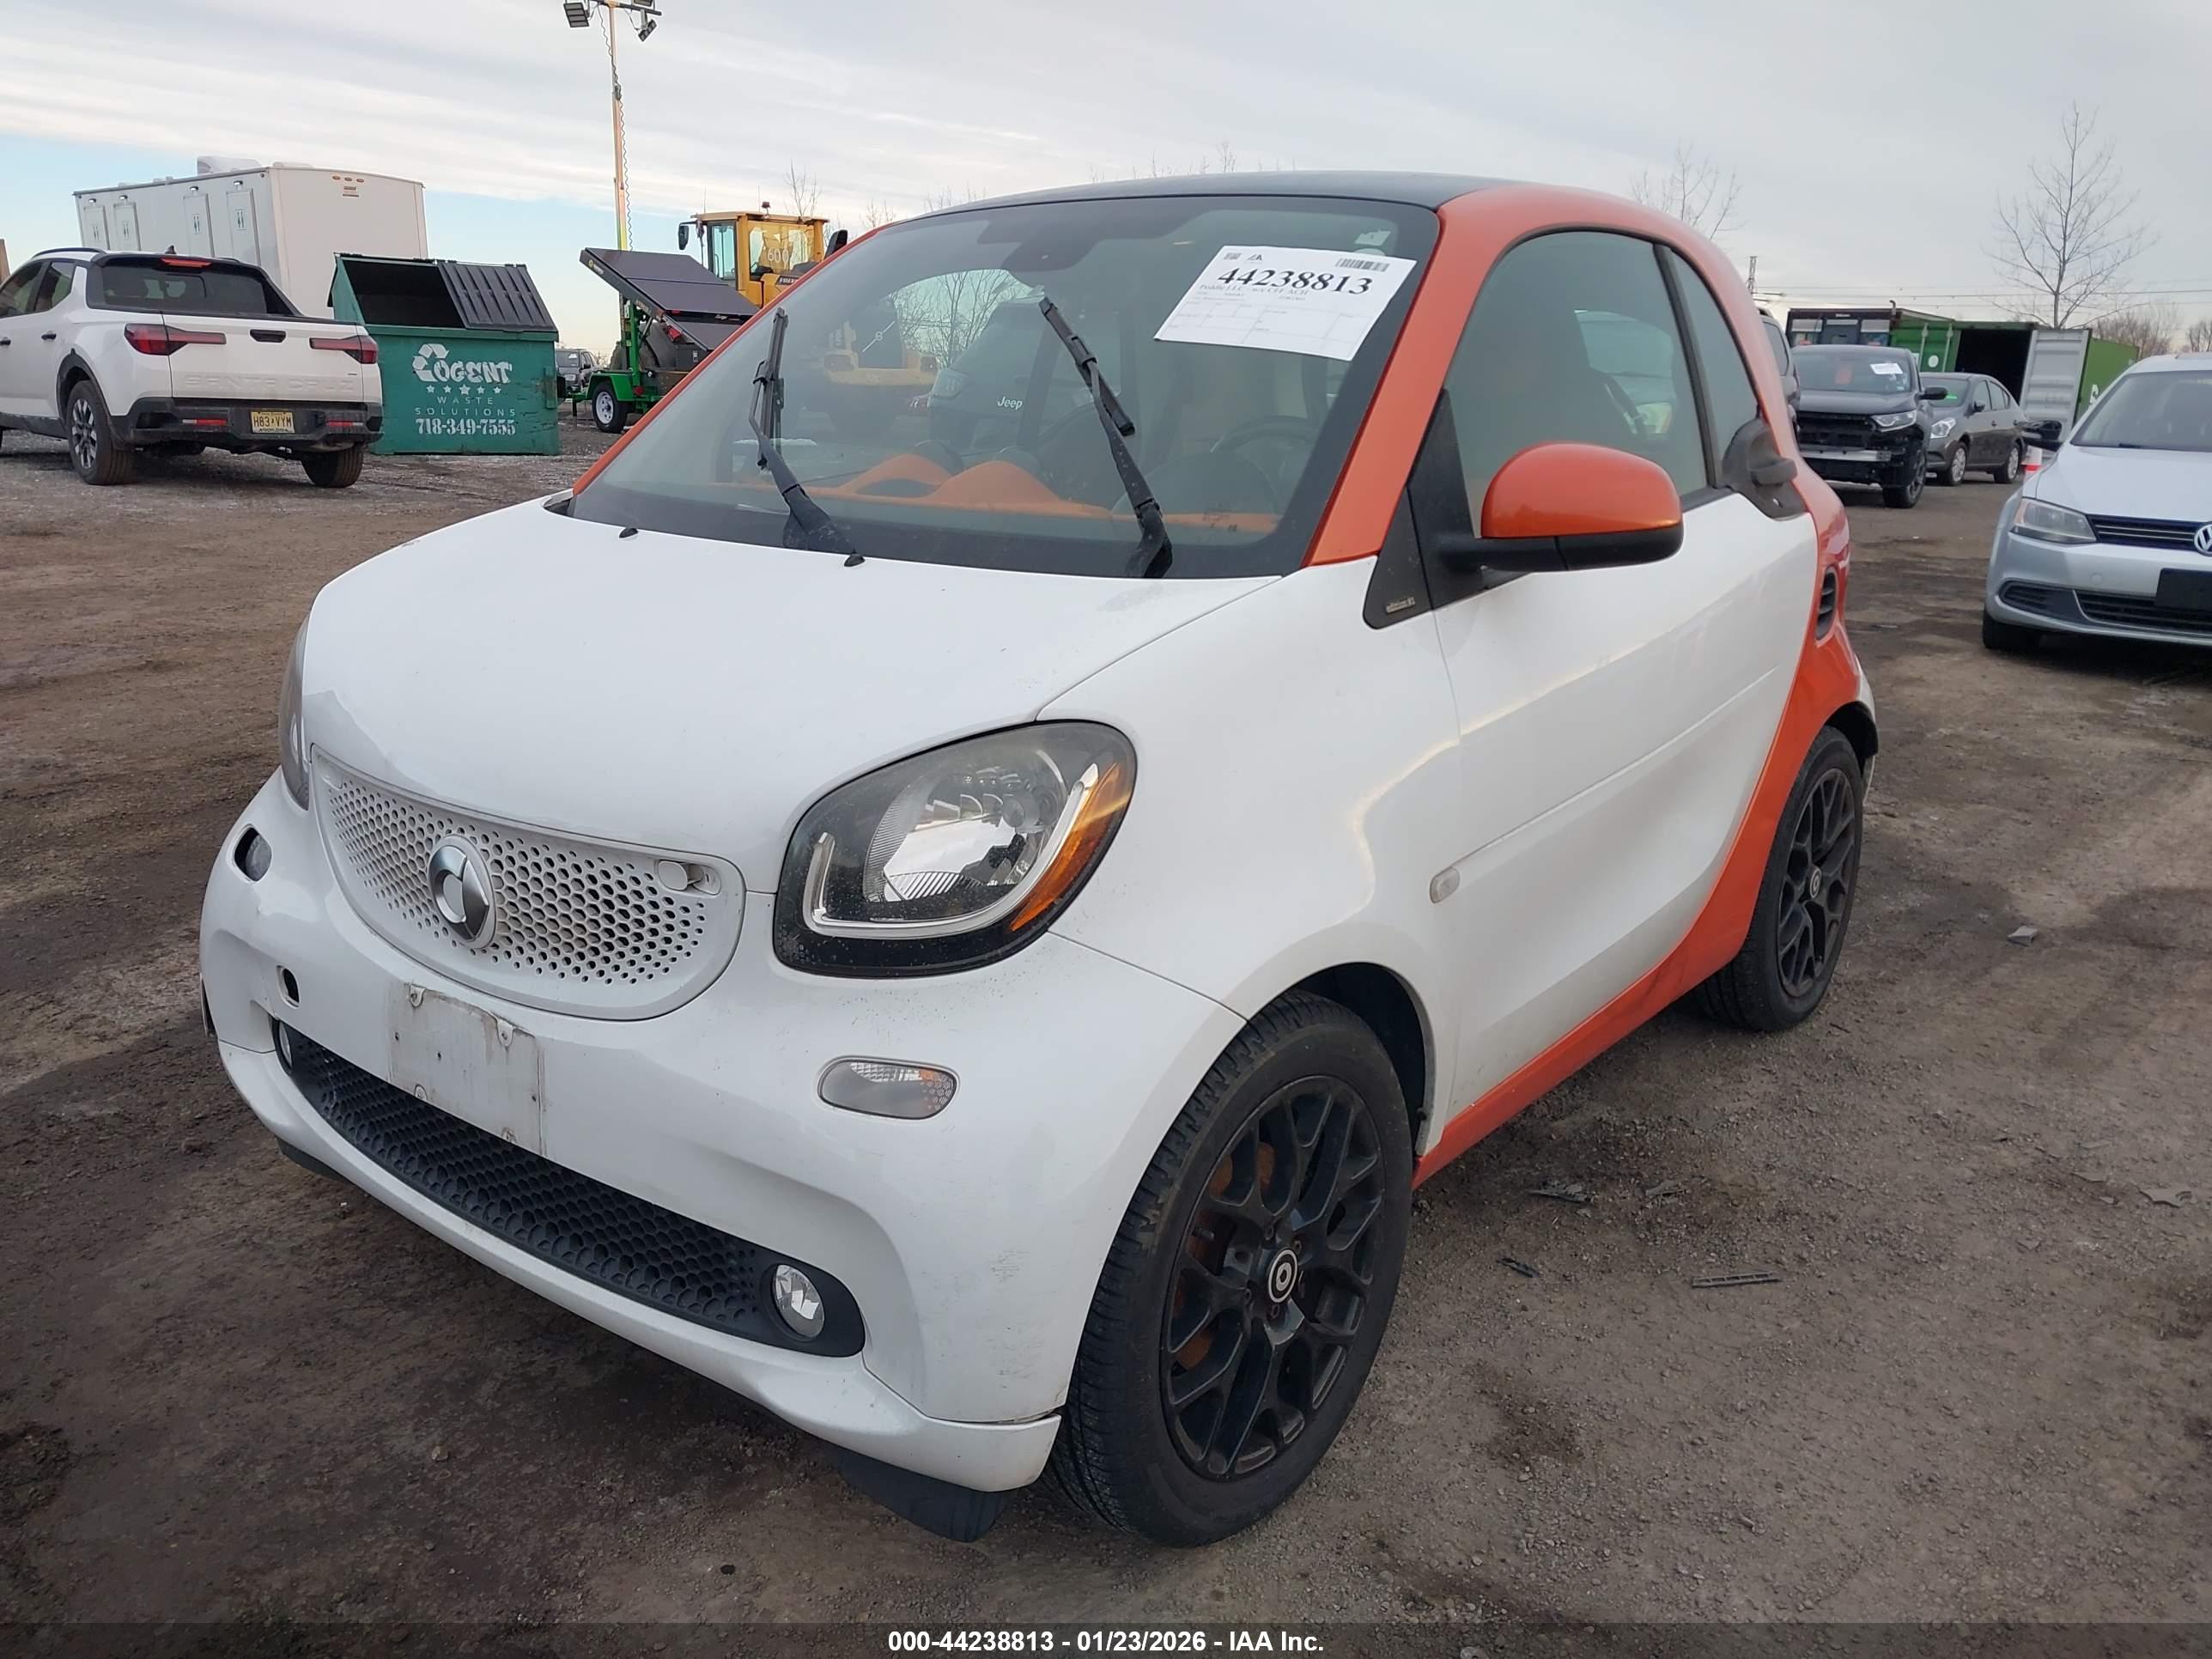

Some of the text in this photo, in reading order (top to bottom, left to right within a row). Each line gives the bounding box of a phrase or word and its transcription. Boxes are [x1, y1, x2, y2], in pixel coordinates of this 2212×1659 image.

[1218, 268, 1372, 294] 44238813
[412, 343, 513, 384] COGENT
[437, 396, 495, 404] WASTE
[997, 396, 1023, 410] Jeep
[415, 407, 515, 417] SOLUTIONS
[416, 418, 516, 435] 718-349-7555
